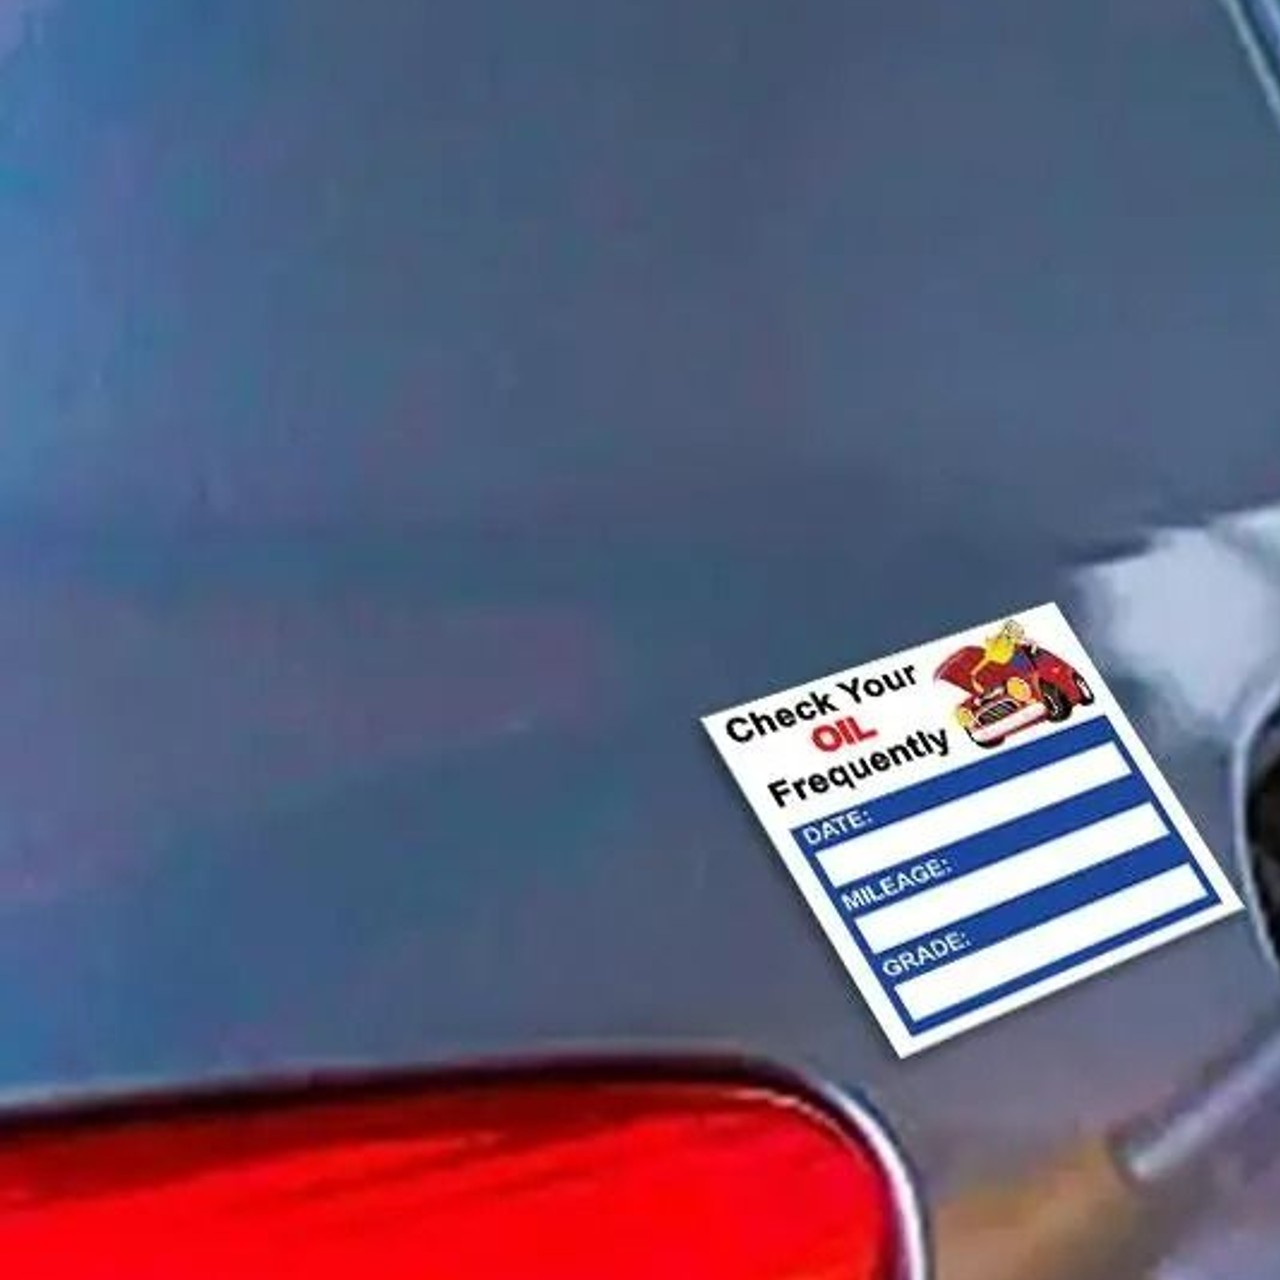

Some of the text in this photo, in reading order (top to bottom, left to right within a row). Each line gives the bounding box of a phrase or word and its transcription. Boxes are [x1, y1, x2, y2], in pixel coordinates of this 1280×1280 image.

[725, 664, 918, 743] Check Your
[810, 716, 878, 752] OIL
[767, 727, 950, 808] Frequently
[802, 809, 873, 845] DATE:
[841, 858, 952, 911] MILEAGE:
[882, 931, 971, 976] GRADE:
